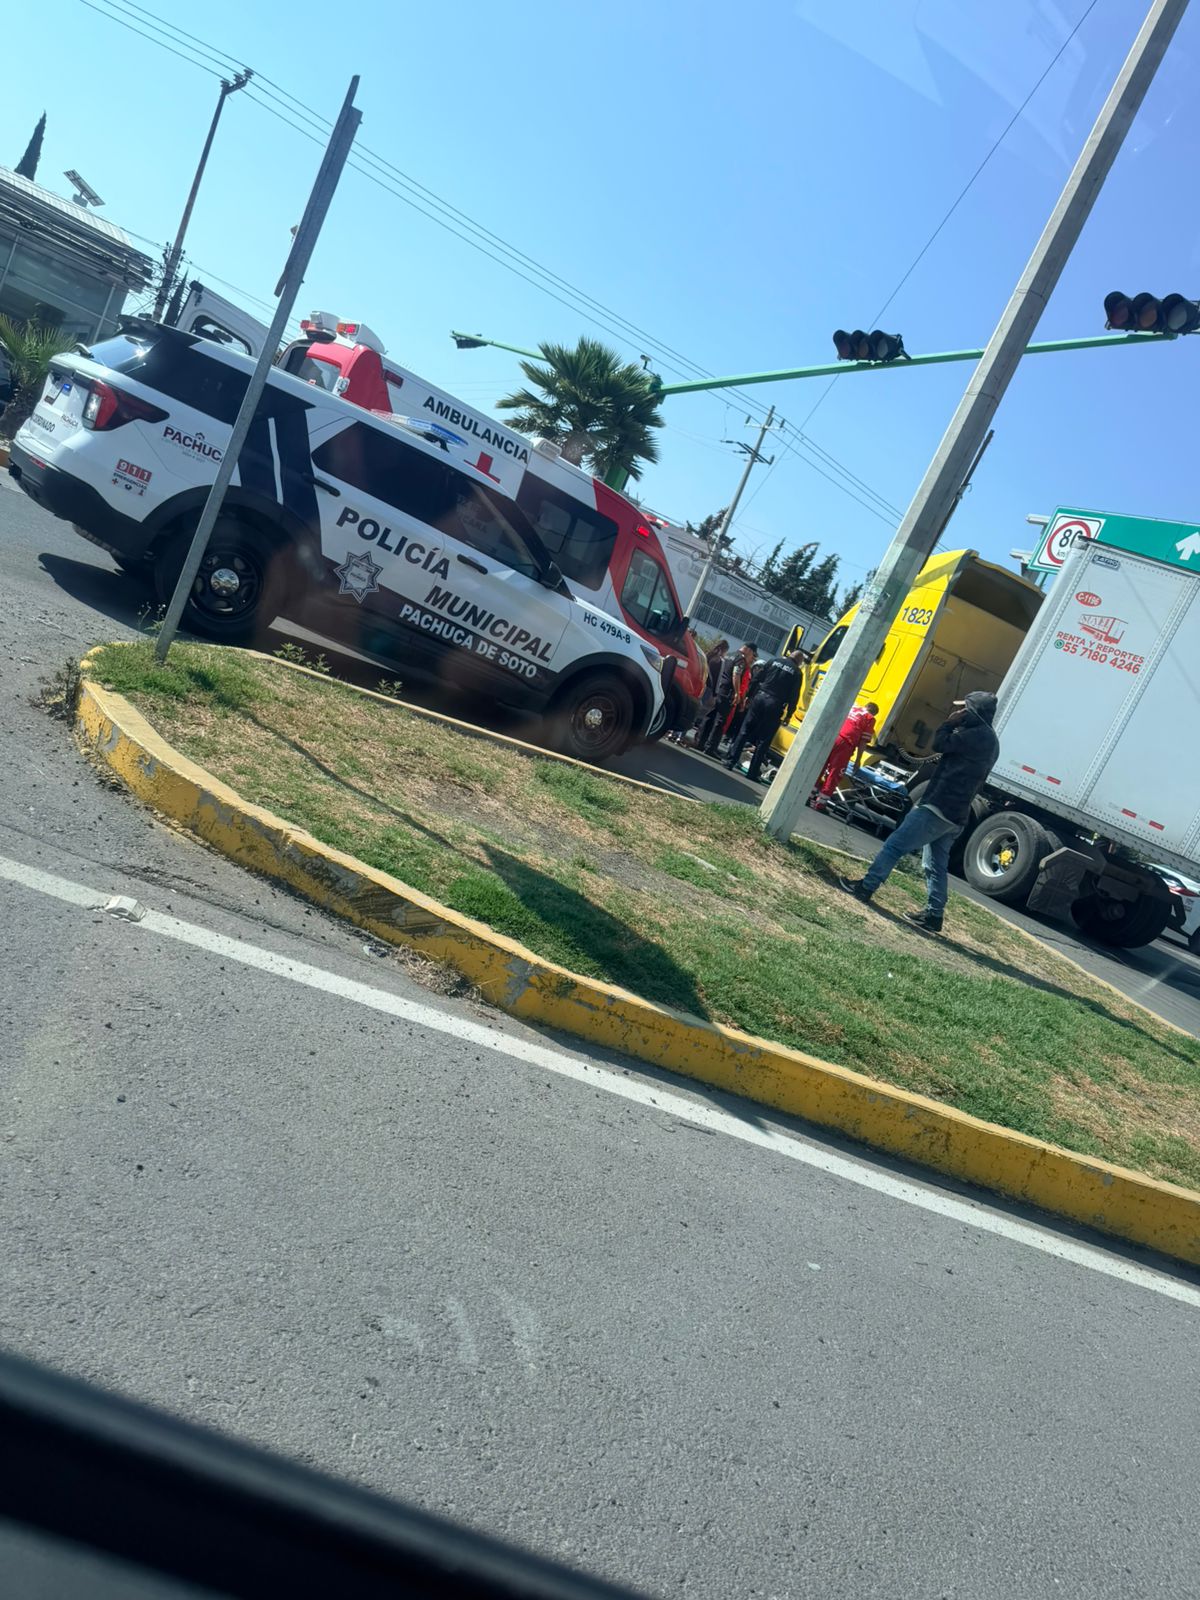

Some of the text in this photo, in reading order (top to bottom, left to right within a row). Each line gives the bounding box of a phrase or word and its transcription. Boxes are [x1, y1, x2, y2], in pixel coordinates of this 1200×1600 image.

[163, 425, 223, 463] PACHUC
[423, 395, 528, 464] AMBULANCIA
[113, 472, 147, 490] EMERGENCIAS
[119, 461, 149, 480] 911
[336, 507, 450, 580] POLICÍA
[424, 585, 552, 662] MUNICIPAL
[583, 611, 631, 644] HG 479A-8
[902, 606, 933, 626] 1823
[400, 604, 537, 678] PACHUCA DE SOTO
[1056, 631, 1145, 664] RENTA Y REPORTES
[1063, 642, 1141, 675] 55 7180 4246
